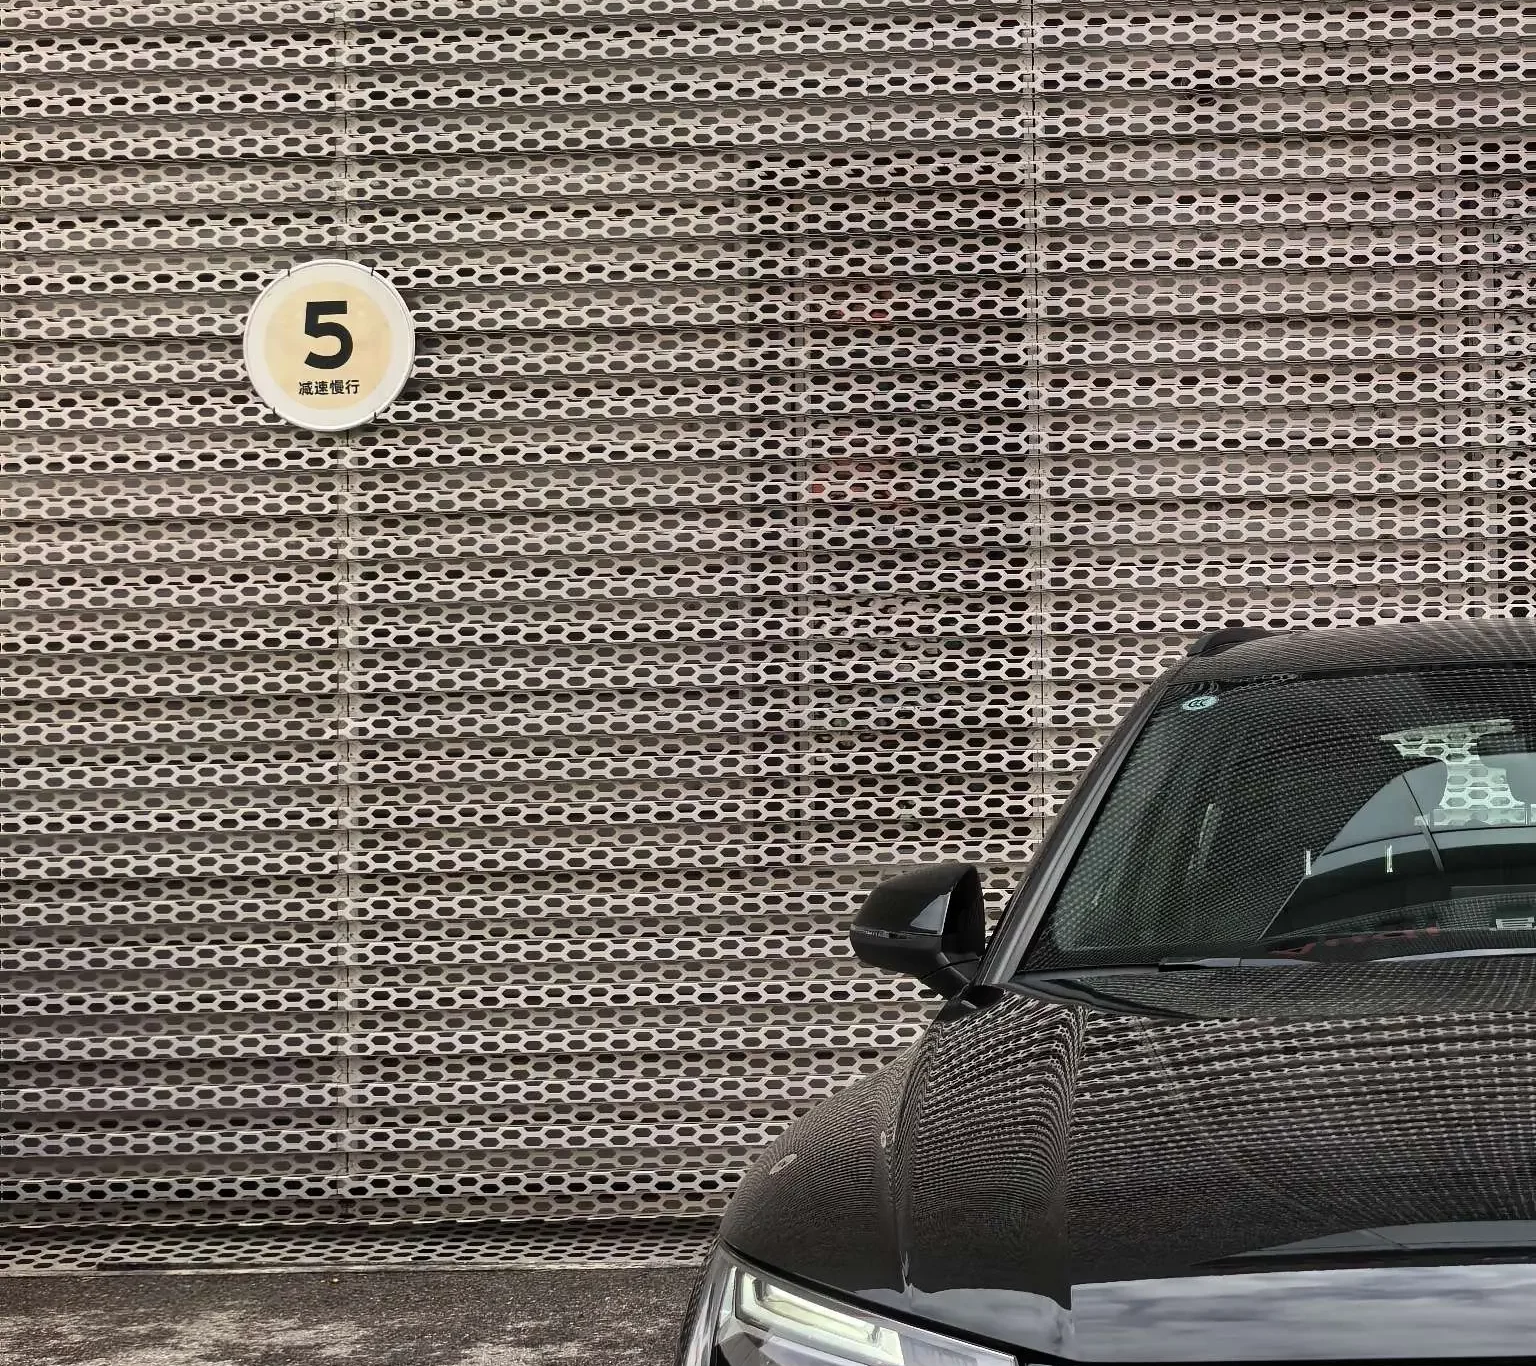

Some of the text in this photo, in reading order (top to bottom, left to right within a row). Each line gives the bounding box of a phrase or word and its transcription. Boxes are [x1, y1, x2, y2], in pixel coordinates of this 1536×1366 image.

[304, 300, 353, 370] 5
[298, 379, 360, 396] 减速慢行
